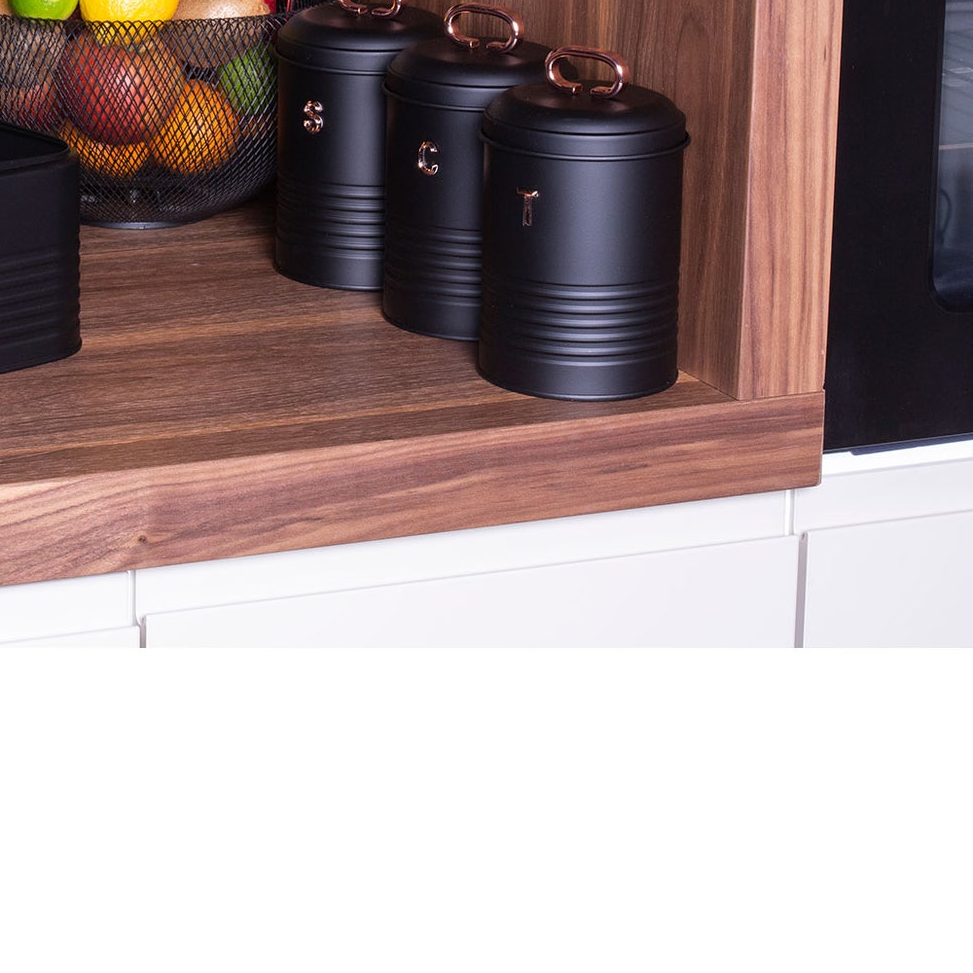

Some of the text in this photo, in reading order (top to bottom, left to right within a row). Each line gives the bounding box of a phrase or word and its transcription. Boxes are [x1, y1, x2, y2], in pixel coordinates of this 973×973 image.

[303, 100, 324, 133] S
[417, 141, 439, 176] C
[516, 187, 540, 227] T
